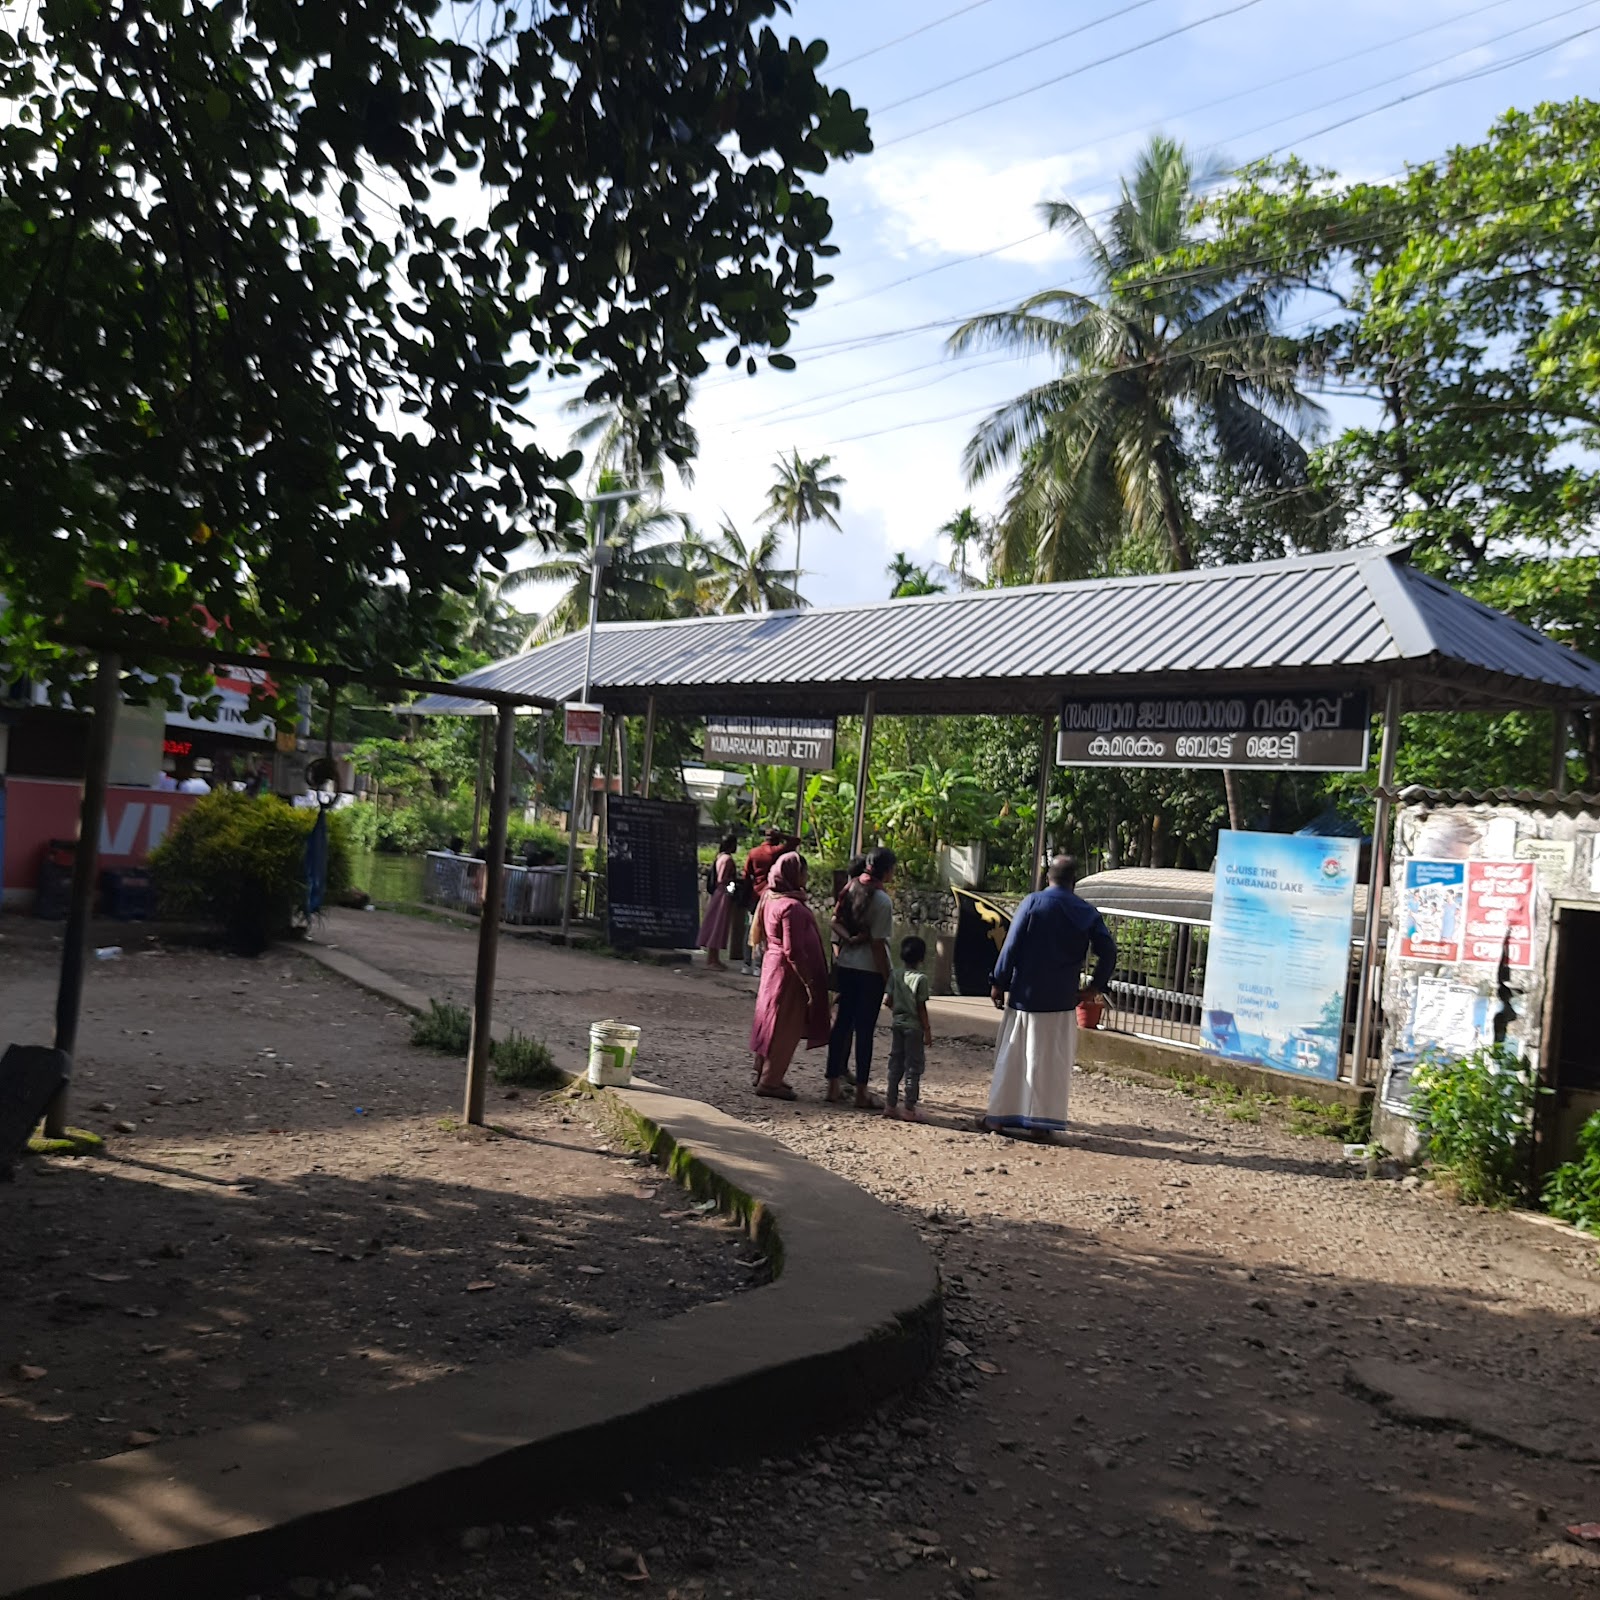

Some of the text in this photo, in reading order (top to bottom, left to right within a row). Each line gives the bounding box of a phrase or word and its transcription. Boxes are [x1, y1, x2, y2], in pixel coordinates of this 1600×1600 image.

[766, 739, 791, 757] BOAT
[792, 741, 821, 759] JETTY
[1088, 731, 1299, 760] കുമരകം ബോട്ട് ജെട്ടി
[1226, 864, 1277, 878] CRUISE THE
[1225, 876, 1277, 890] VEMBANAD
[1280, 881, 1303, 893] LAKE
